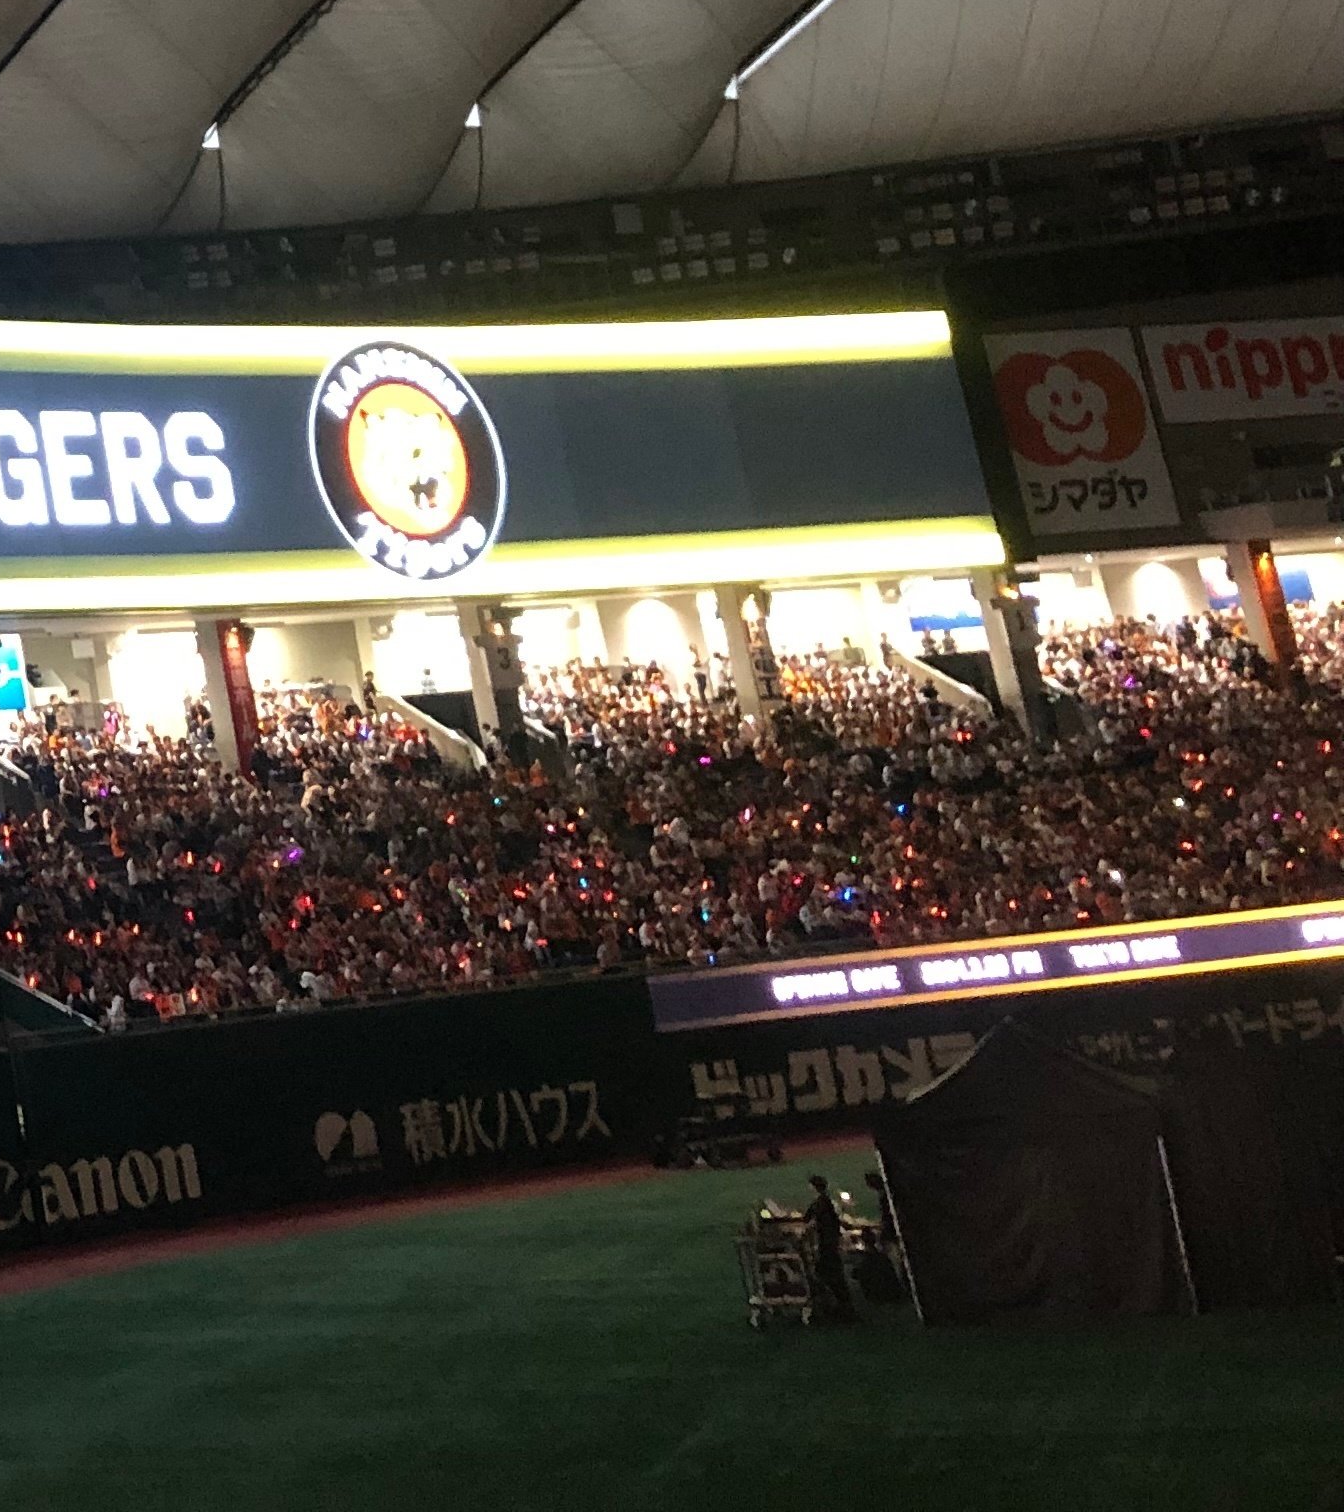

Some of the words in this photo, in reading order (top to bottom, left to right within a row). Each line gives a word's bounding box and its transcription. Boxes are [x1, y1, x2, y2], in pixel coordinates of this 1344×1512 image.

[1163, 326, 1344, 400] nipp
[1026, 468, 1148, 515] シマダヤ
[399, 1080, 612, 1164] 積水ハウス
